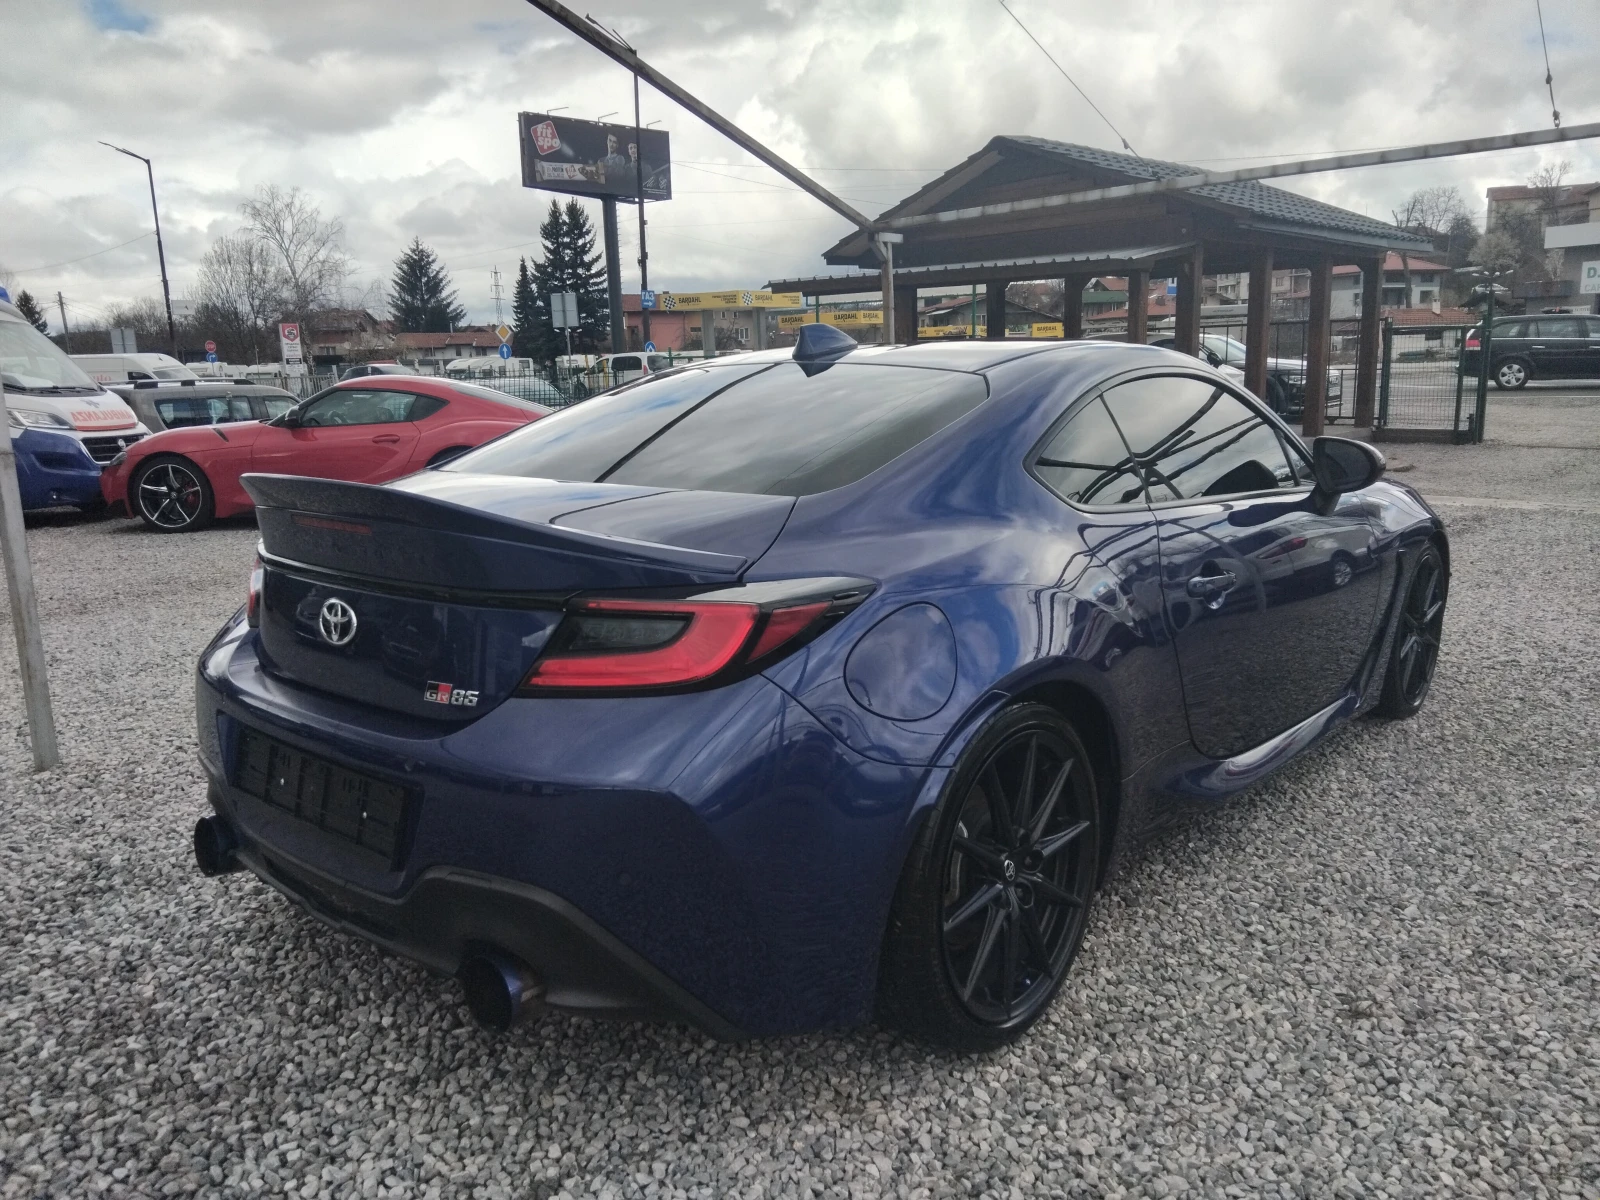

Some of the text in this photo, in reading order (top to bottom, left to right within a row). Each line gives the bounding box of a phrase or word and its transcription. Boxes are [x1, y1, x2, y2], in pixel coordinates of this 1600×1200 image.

[537, 123, 553, 138] fit
[537, 136, 561, 150] spo
[641, 291, 655, 300] ГАЗ
[755, 294, 773, 304] BARDAHL
[679, 296, 701, 306] BARDAHL
[781, 316, 804, 325] BARDAHL
[833, 313, 858, 322] BARDAHL
[862, 312, 880, 320] BARDAHL
